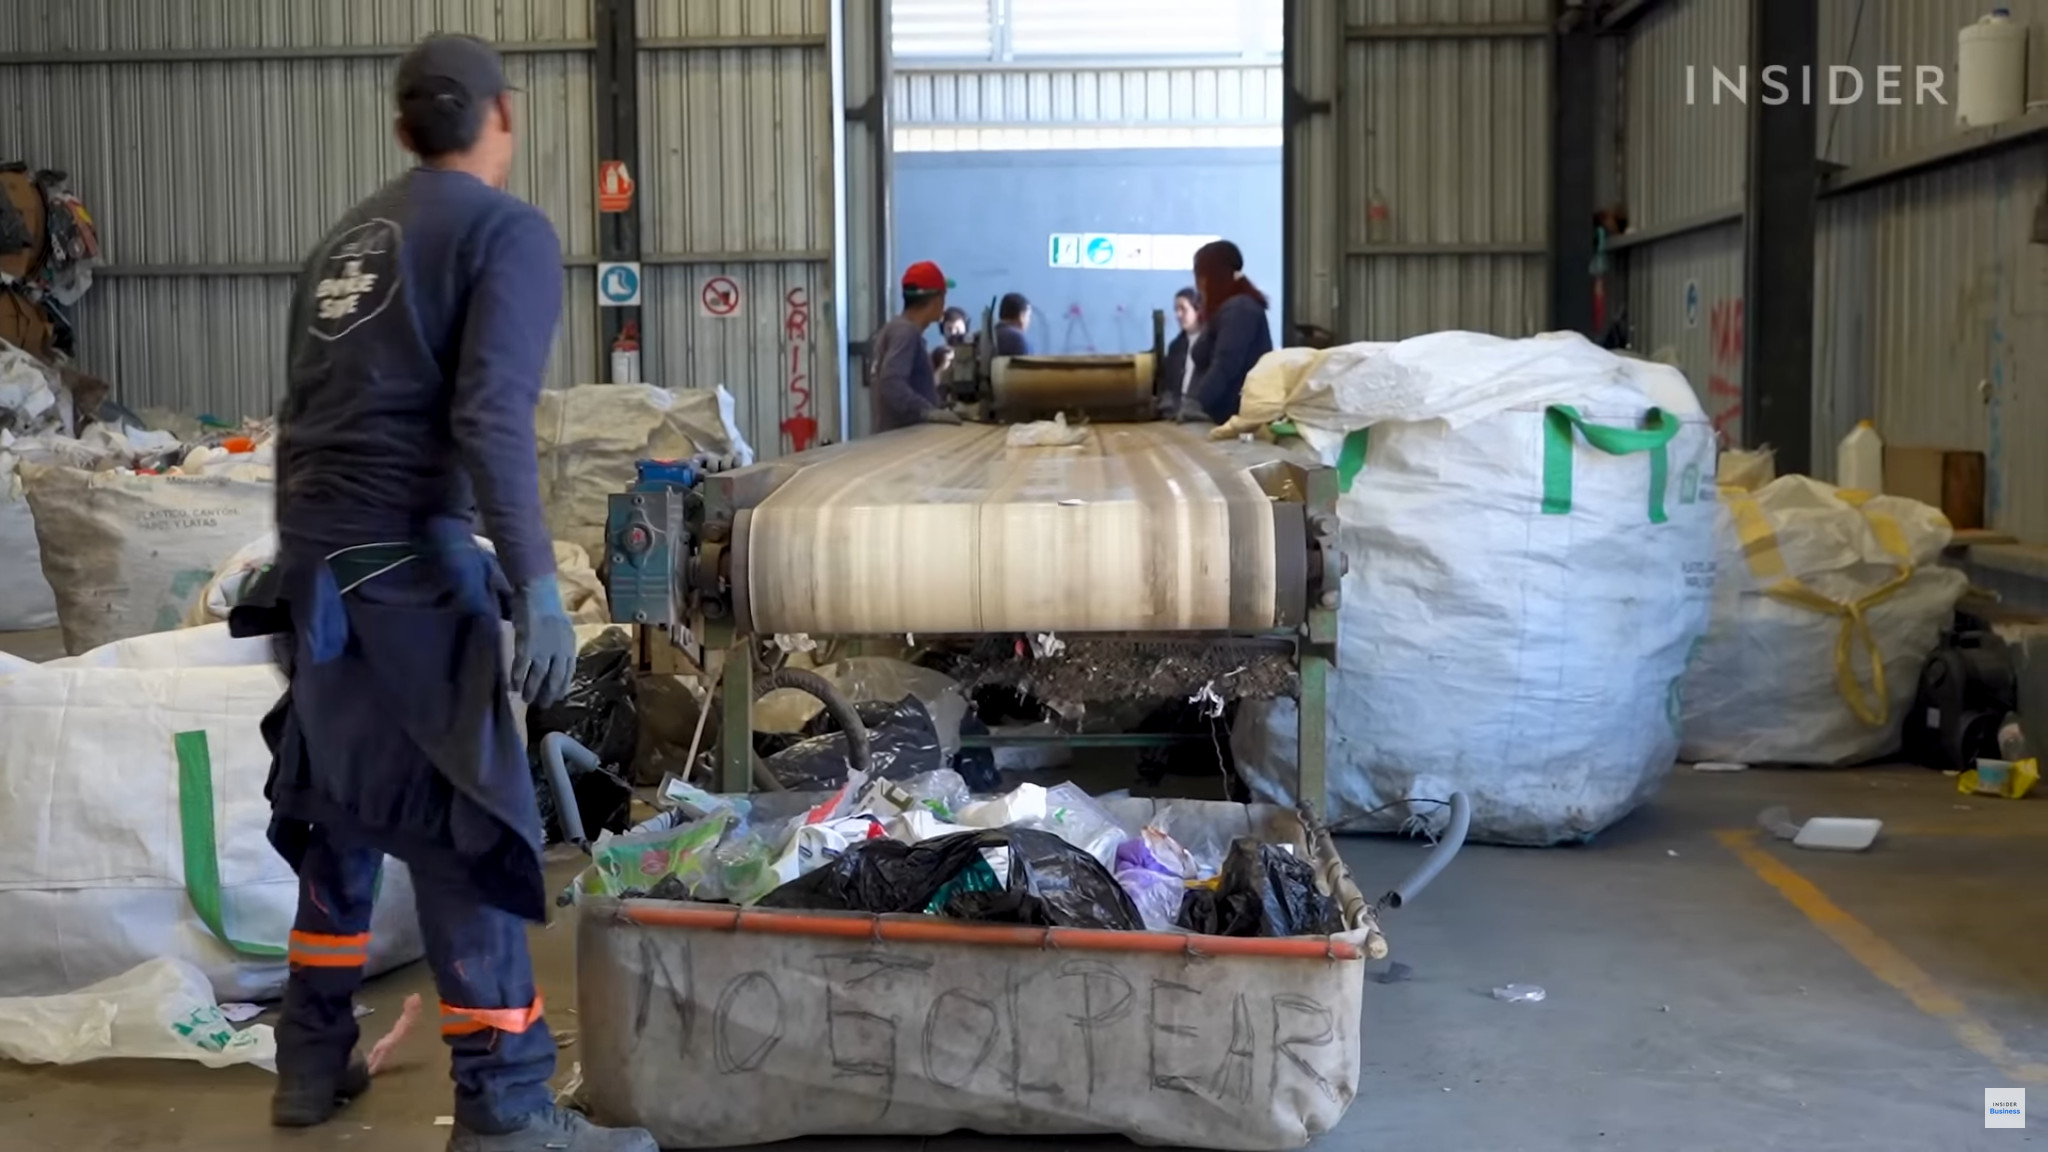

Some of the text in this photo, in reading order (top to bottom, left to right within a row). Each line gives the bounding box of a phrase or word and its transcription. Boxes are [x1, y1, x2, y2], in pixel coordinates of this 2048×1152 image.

[786, 287, 810, 410] CRIS
[631, 936, 1338, 1120] NO GOLPEAR
